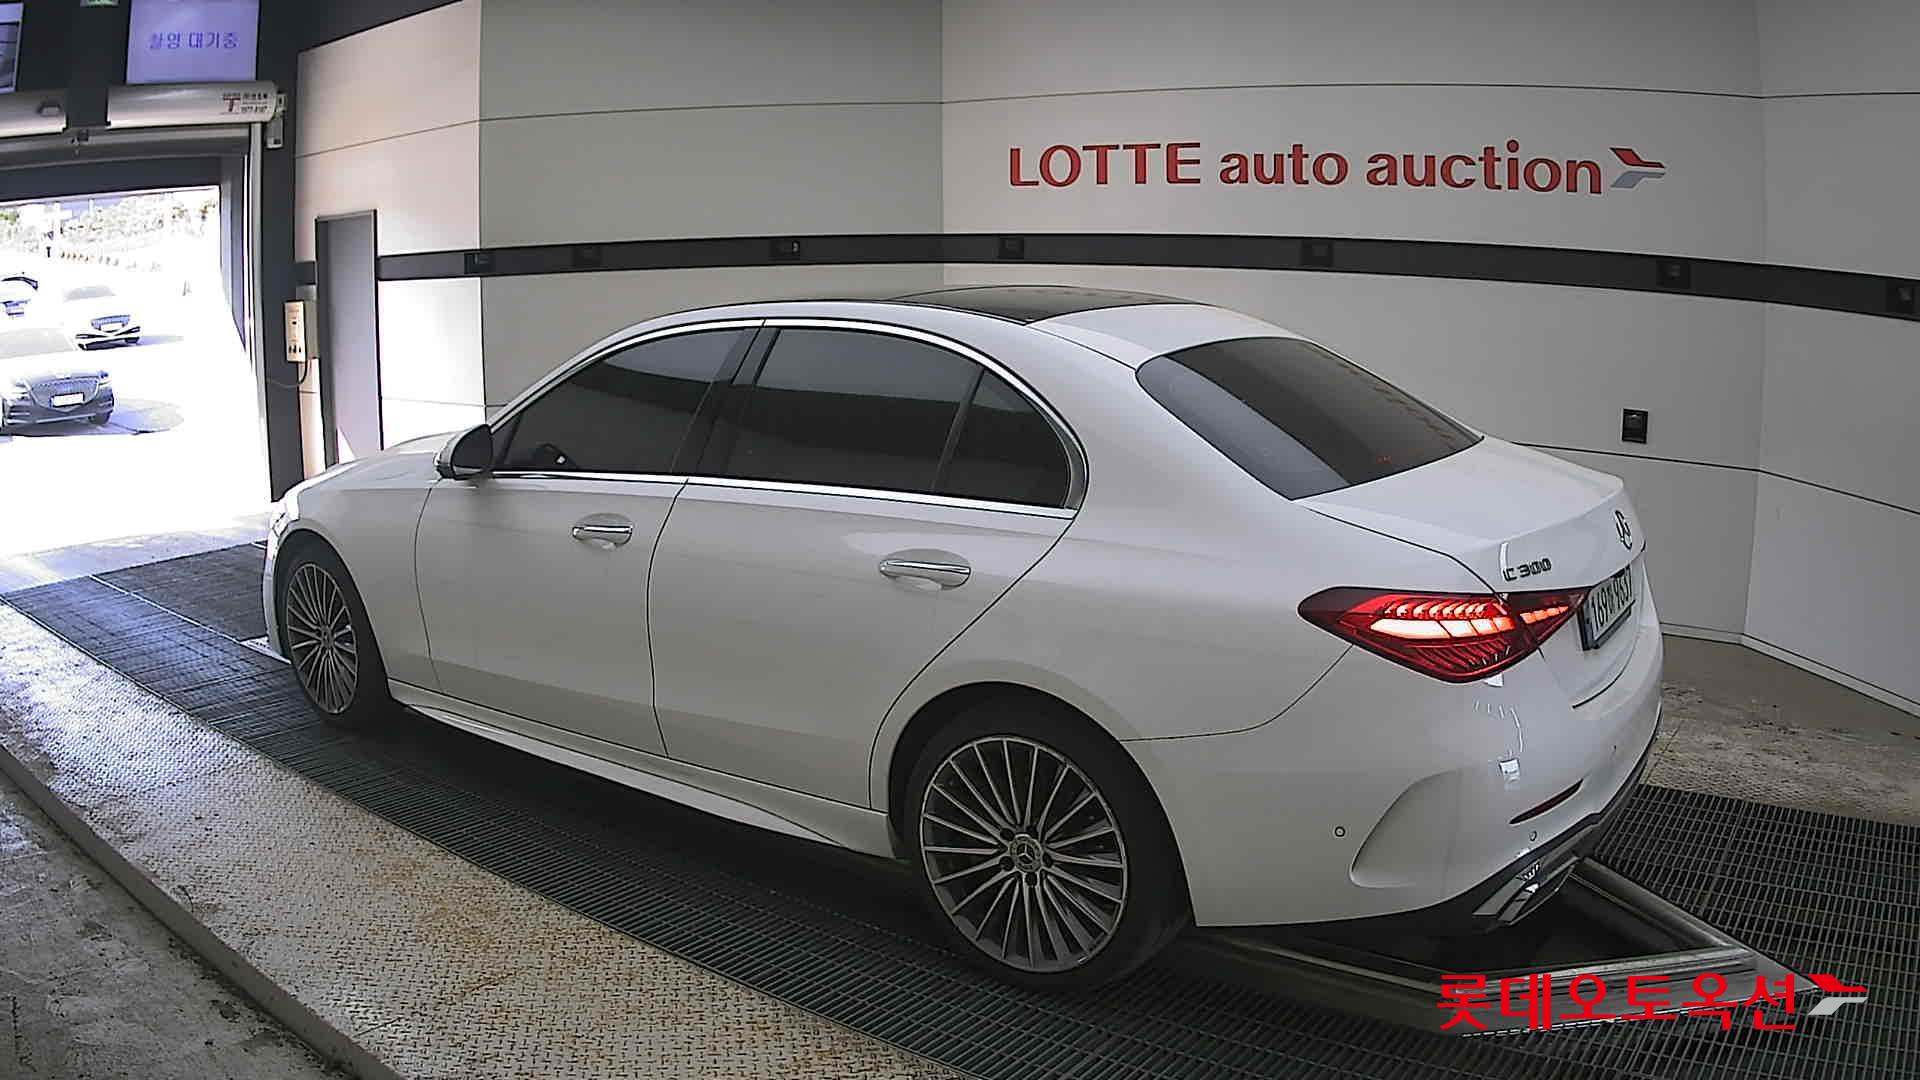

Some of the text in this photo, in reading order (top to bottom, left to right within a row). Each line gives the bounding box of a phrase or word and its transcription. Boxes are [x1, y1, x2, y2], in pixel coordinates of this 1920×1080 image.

[1009, 139, 1602, 195] LOTTE auto auction
[1503, 557, 1552, 581] C 300
